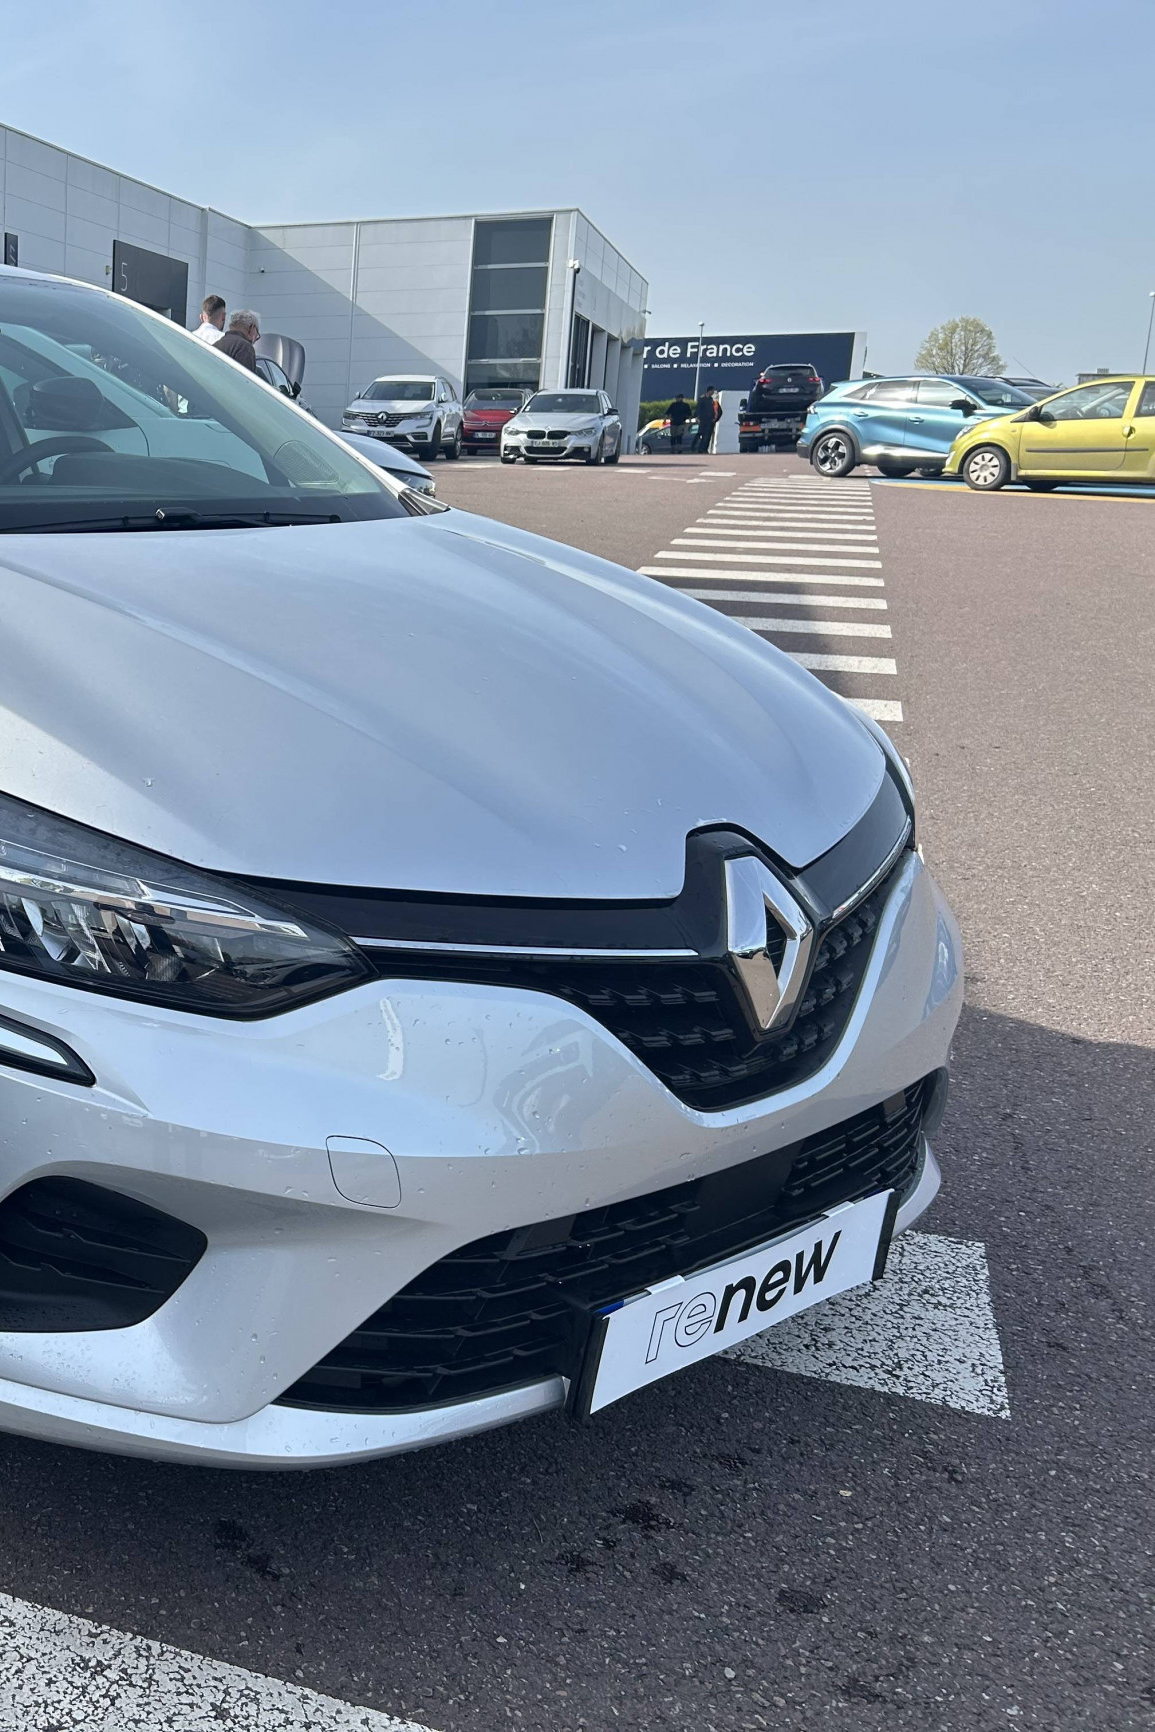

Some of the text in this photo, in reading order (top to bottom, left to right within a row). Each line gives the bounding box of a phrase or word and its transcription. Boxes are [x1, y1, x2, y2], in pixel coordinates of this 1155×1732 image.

[120, 262, 128, 292] 5
[655, 342, 681, 358] de
[686, 341, 756, 358] France
[644, 1229, 843, 1365] renew
